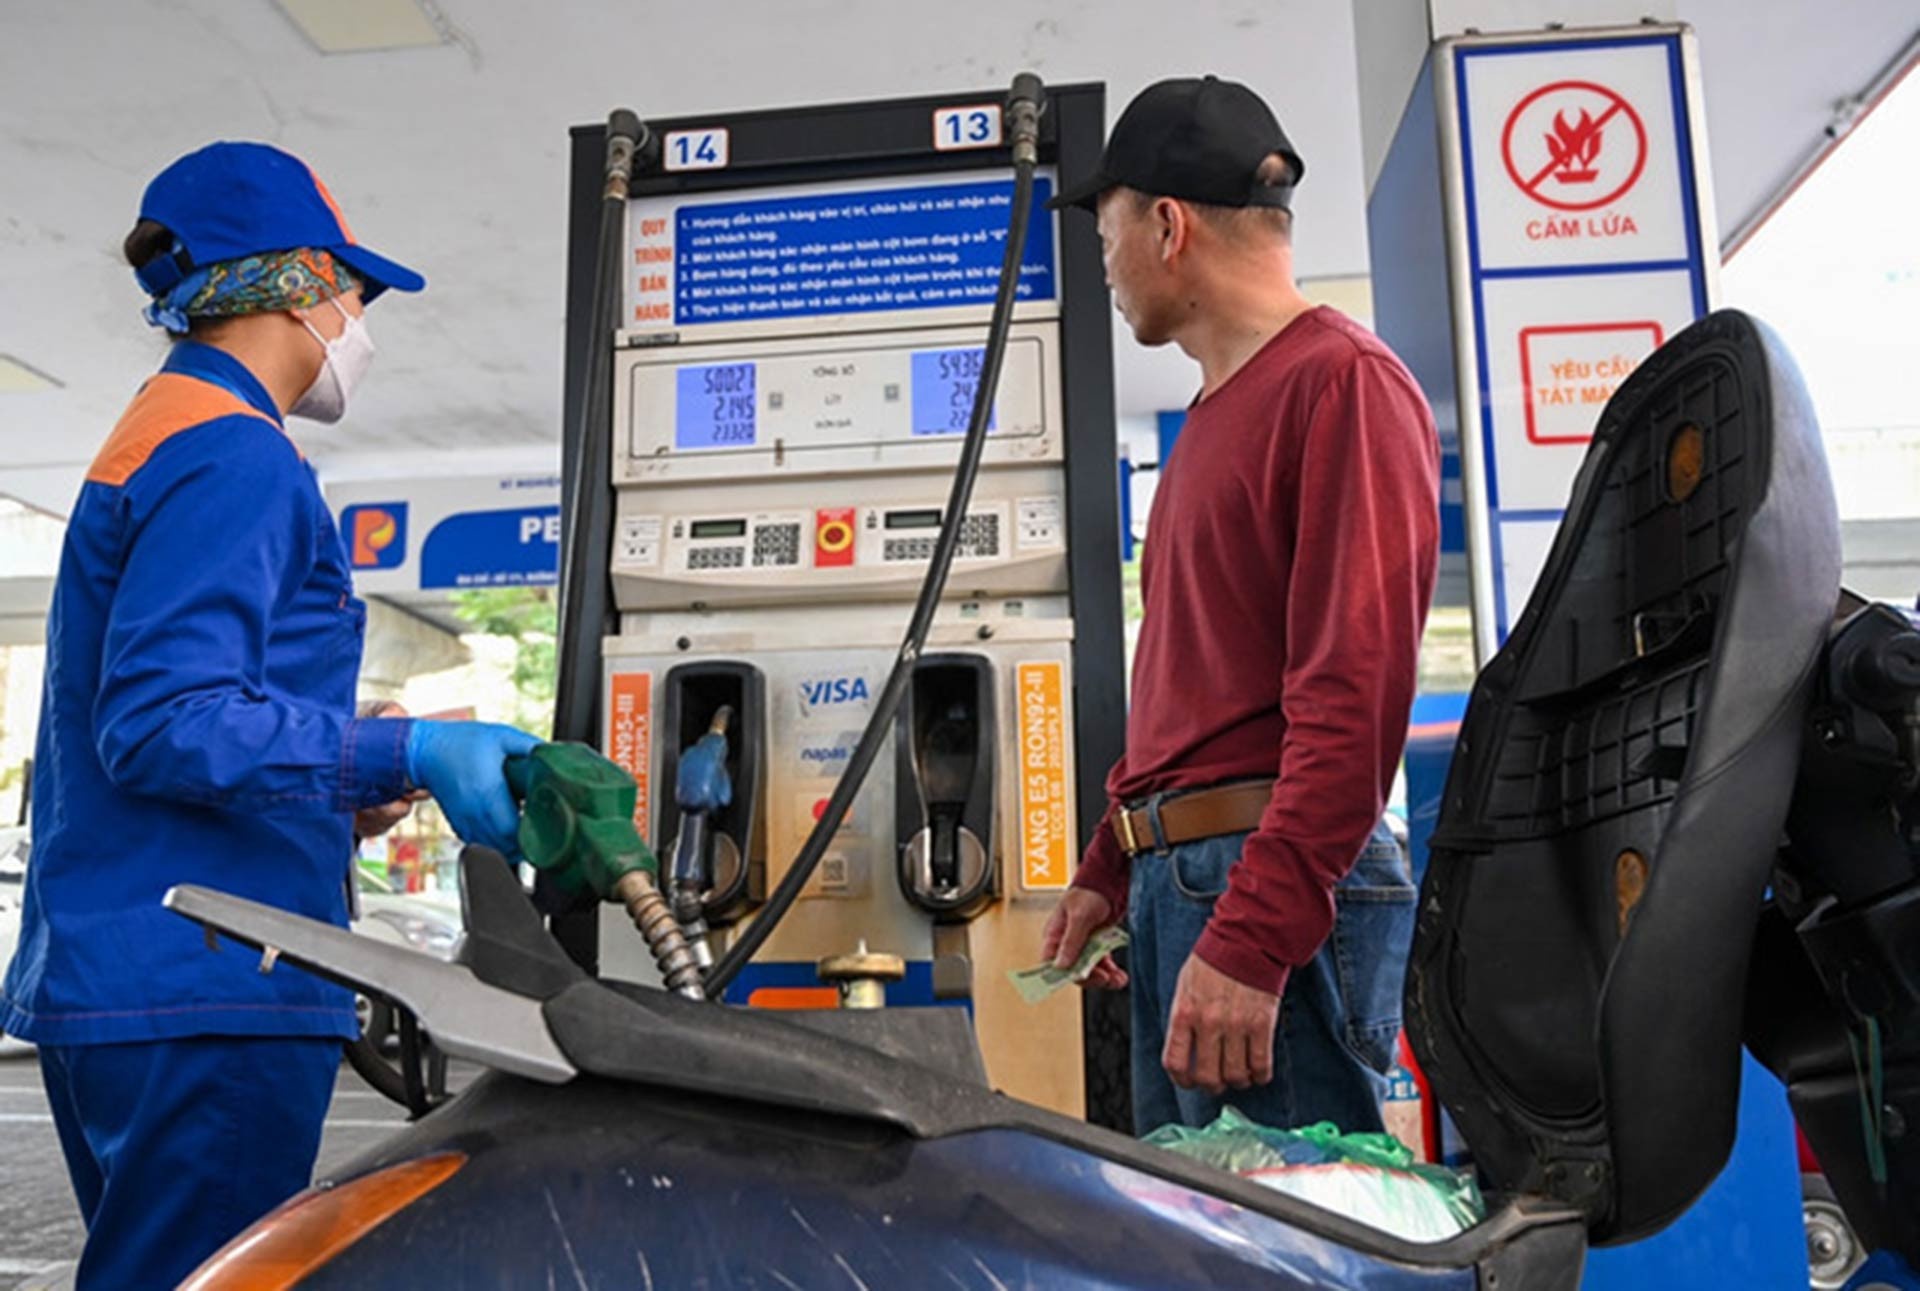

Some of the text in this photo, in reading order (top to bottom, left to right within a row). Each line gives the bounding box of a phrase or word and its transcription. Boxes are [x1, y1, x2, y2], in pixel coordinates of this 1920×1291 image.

[946, 112, 990, 142] 13
[675, 135, 718, 165] 14
[1525, 211, 1638, 240] CẤM LỬA
[801, 677, 869, 706] VISA
[1025, 671, 1048, 768] RON92-II
[1028, 773, 1048, 802] E5
